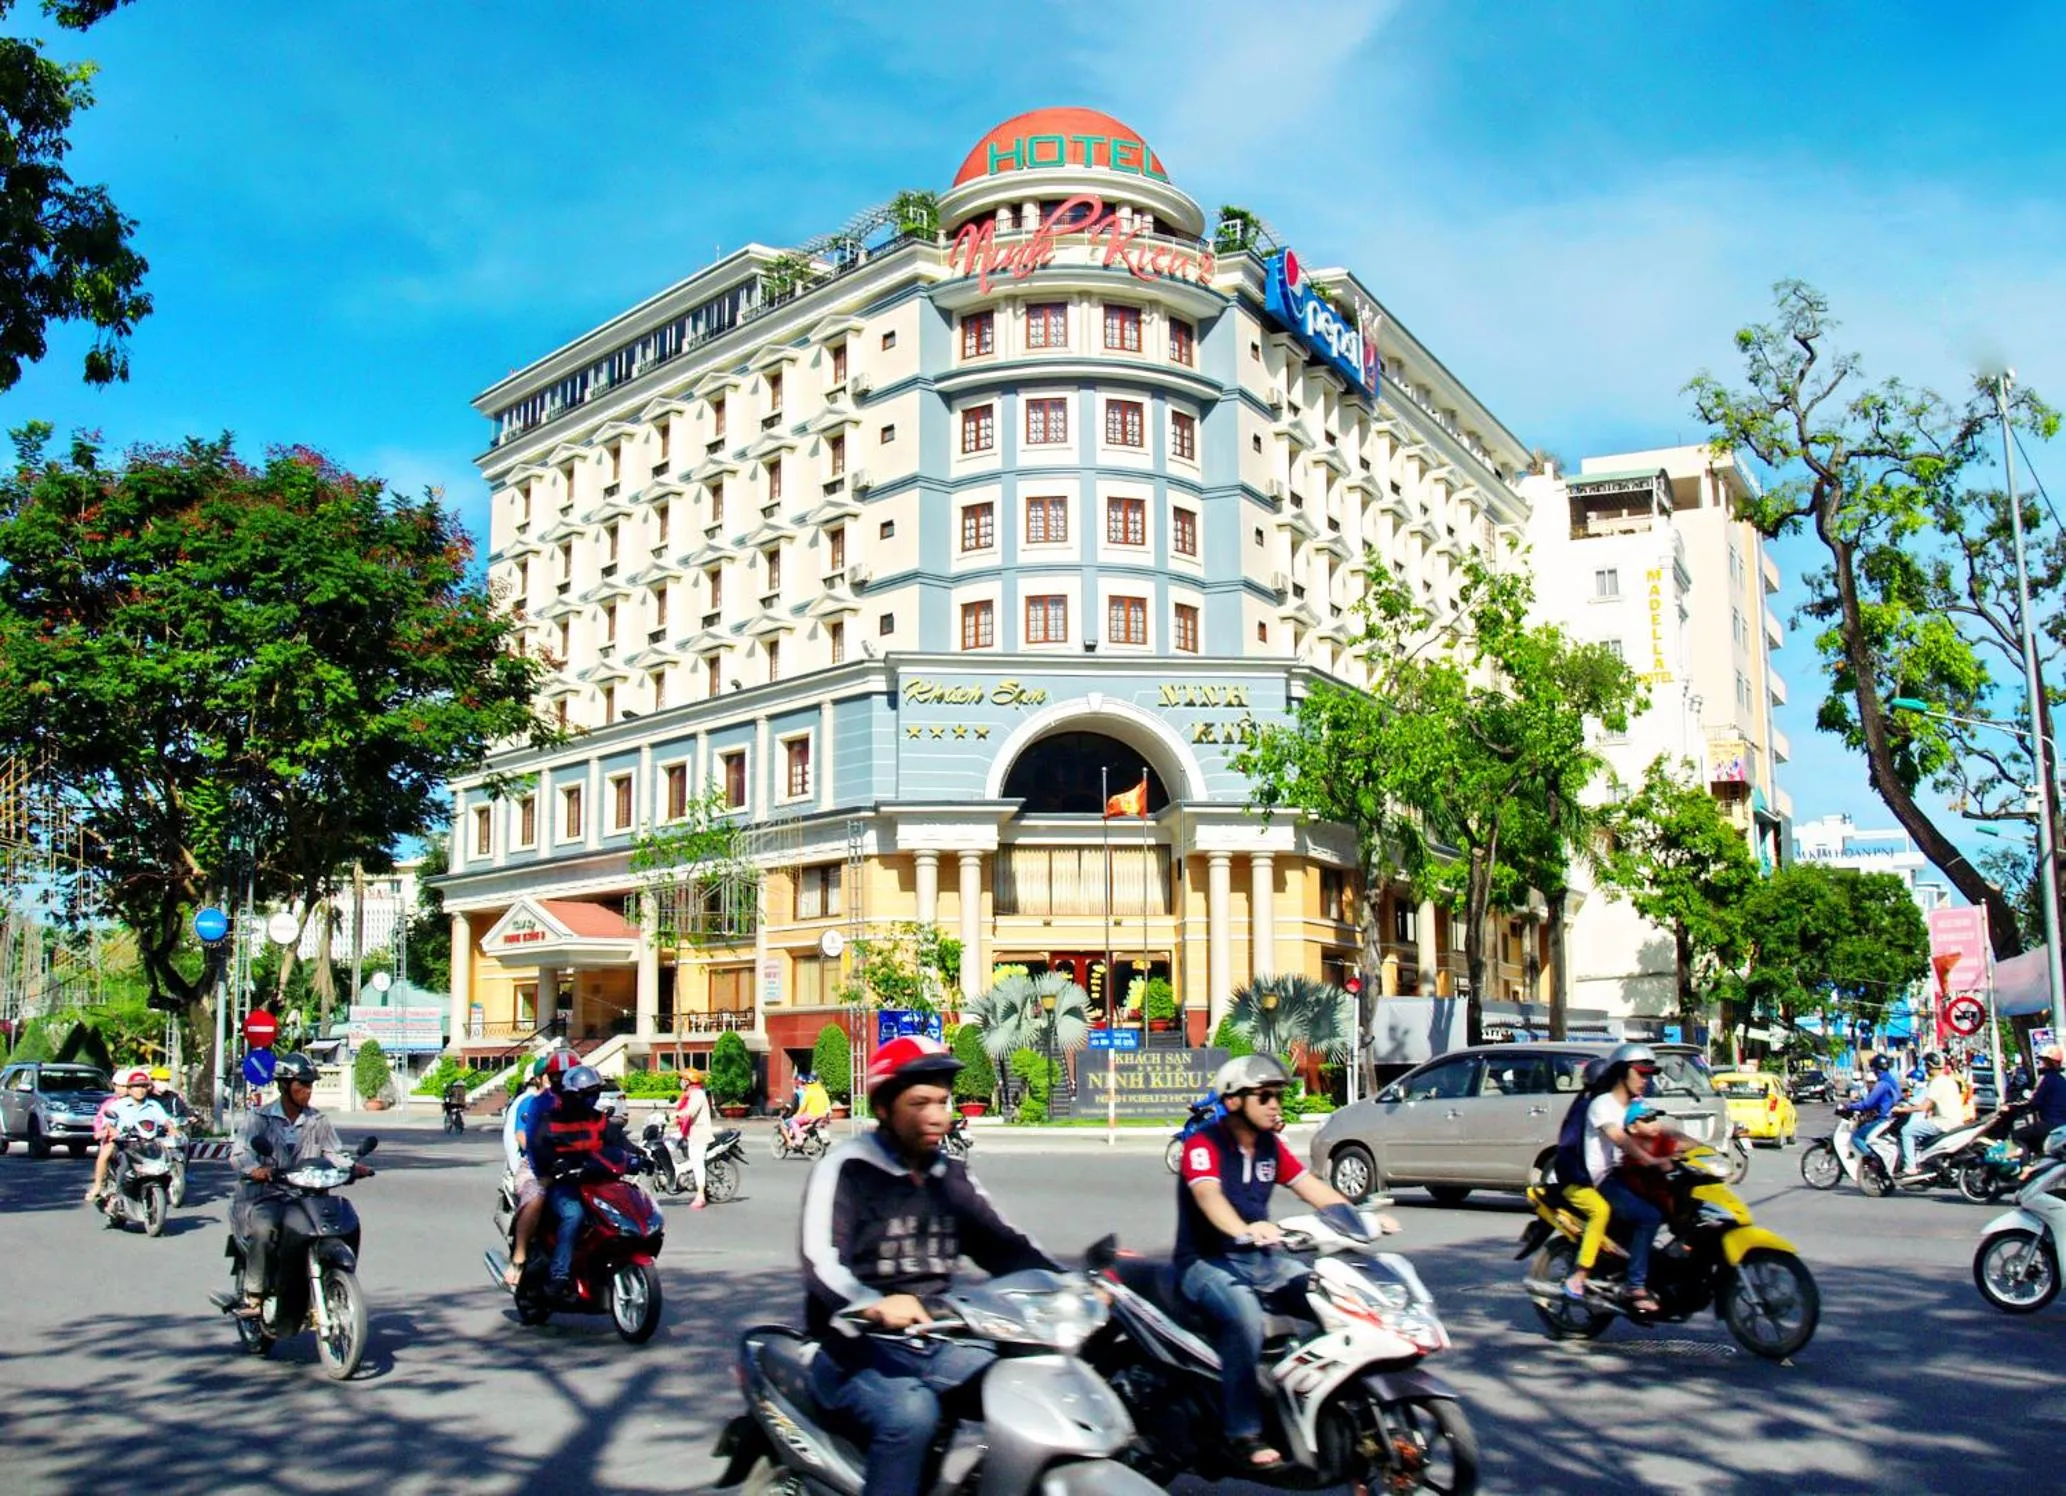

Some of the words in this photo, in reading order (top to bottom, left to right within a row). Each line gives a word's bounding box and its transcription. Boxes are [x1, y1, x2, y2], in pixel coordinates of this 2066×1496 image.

[987, 134, 1169, 182] HOTEL
[1646, 568, 1665, 670] MADELLA
[1158, 684, 1249, 708] NINH
[1114, 1050, 1161, 1065] KHÁCH
